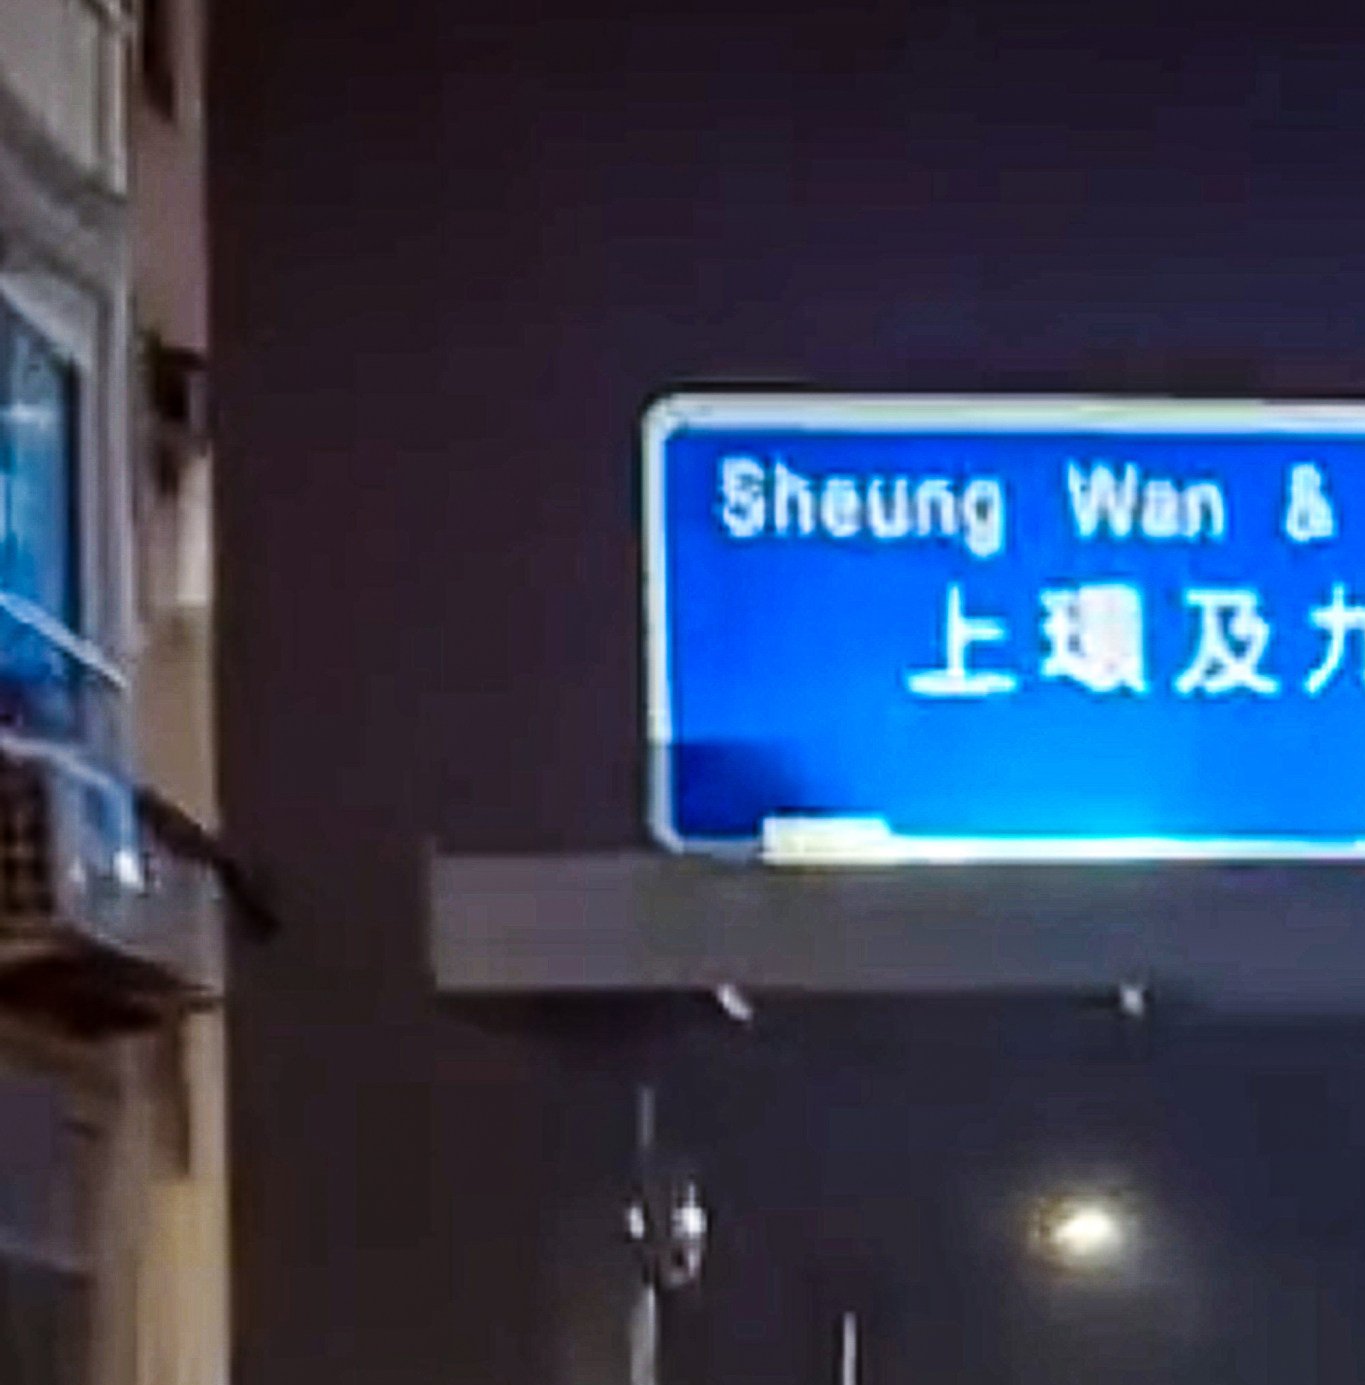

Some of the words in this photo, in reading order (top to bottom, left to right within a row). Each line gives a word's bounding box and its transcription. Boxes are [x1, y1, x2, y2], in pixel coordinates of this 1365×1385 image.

[721, 455, 1003, 558] Sheung
[1066, 460, 1225, 538] Wan
[1283, 462, 1335, 543] &
